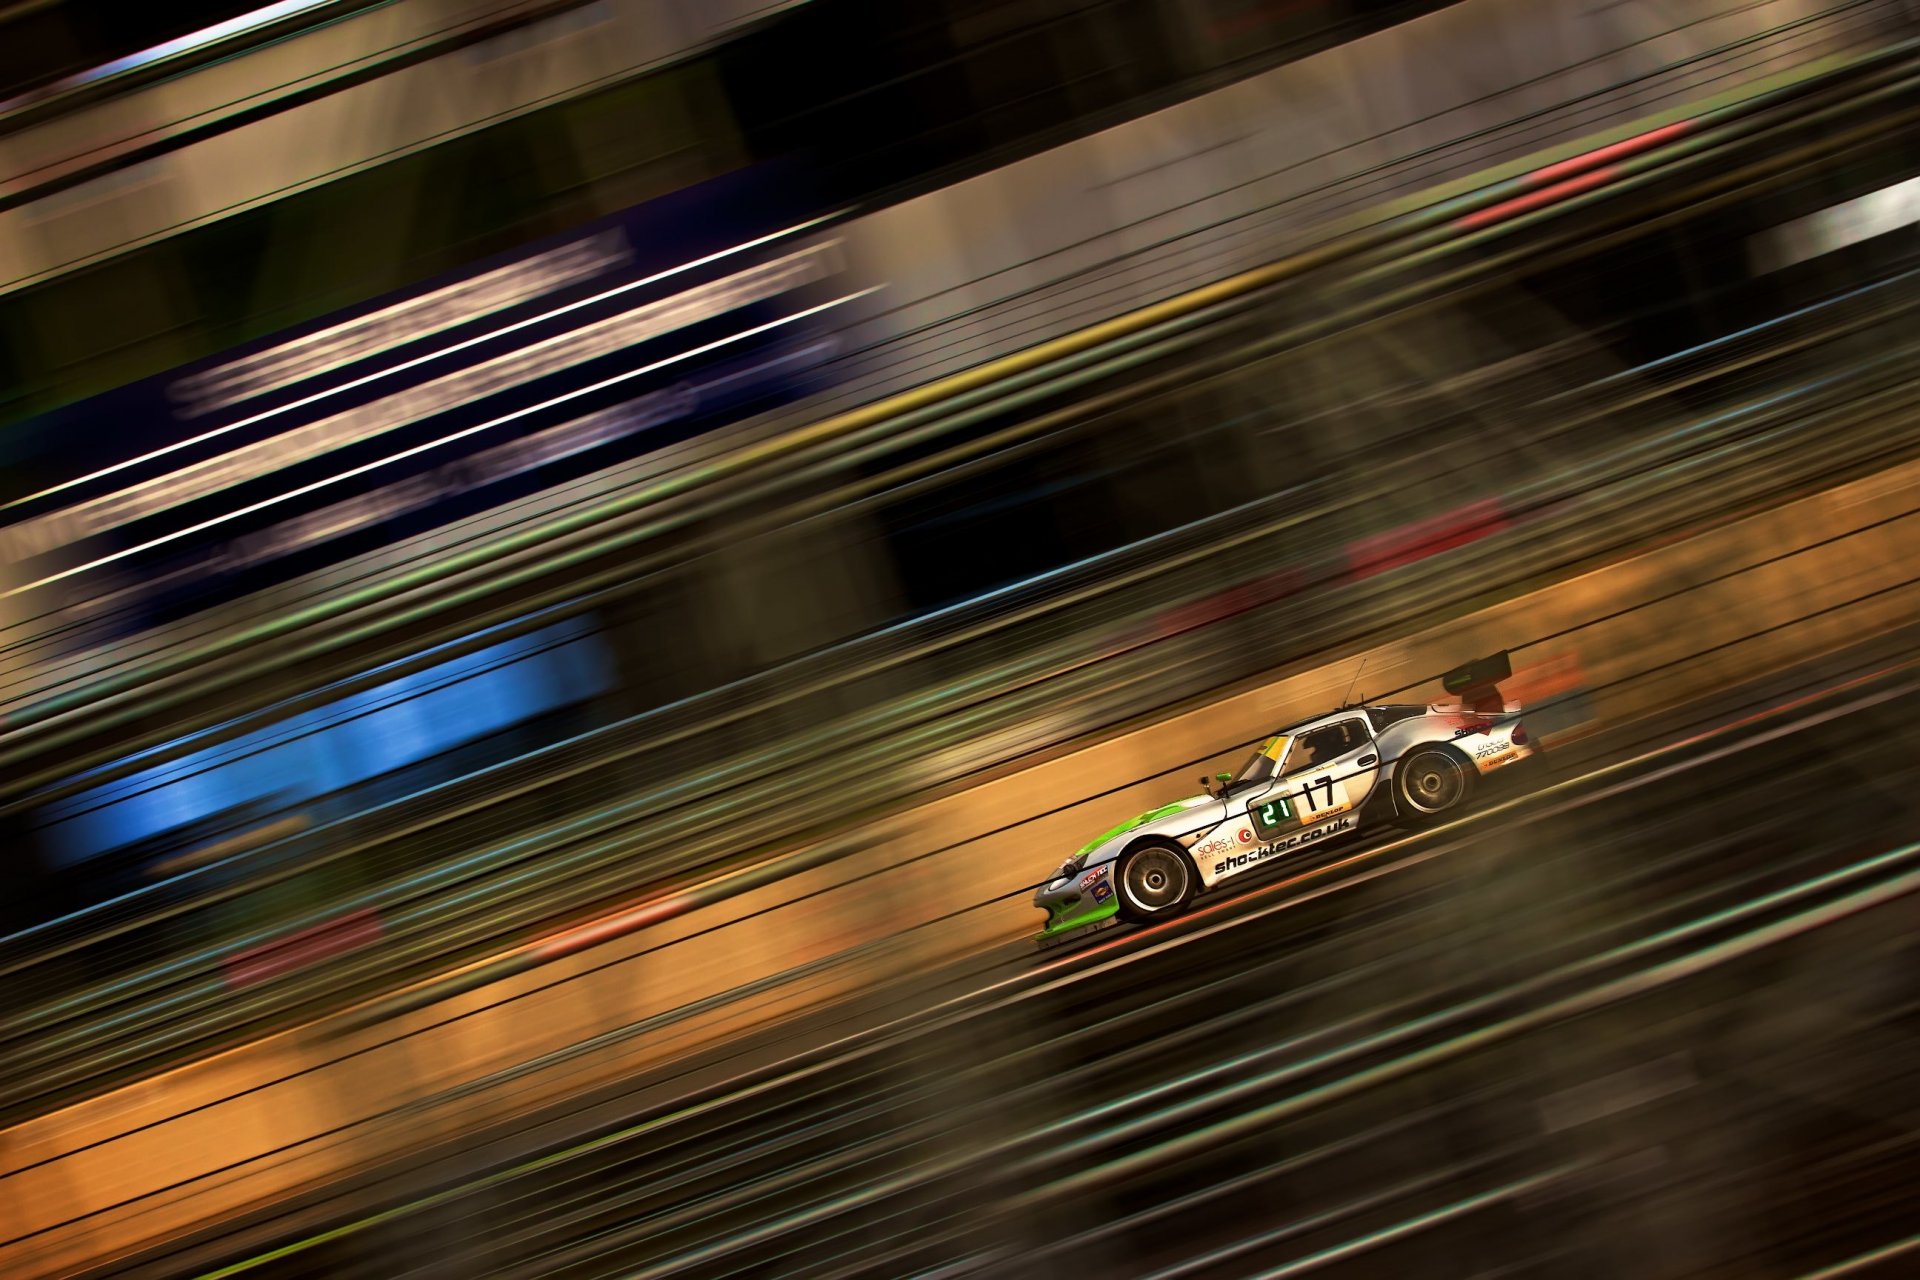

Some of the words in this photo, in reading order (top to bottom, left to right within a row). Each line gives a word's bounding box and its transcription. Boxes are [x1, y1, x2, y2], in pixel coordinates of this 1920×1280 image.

[1303, 775, 1333, 811] 17
[1262, 800, 1289, 825] 21
[1315, 806, 1344, 819] DUNLOP
[1214, 818, 1351, 875] shocktec.co.uk
